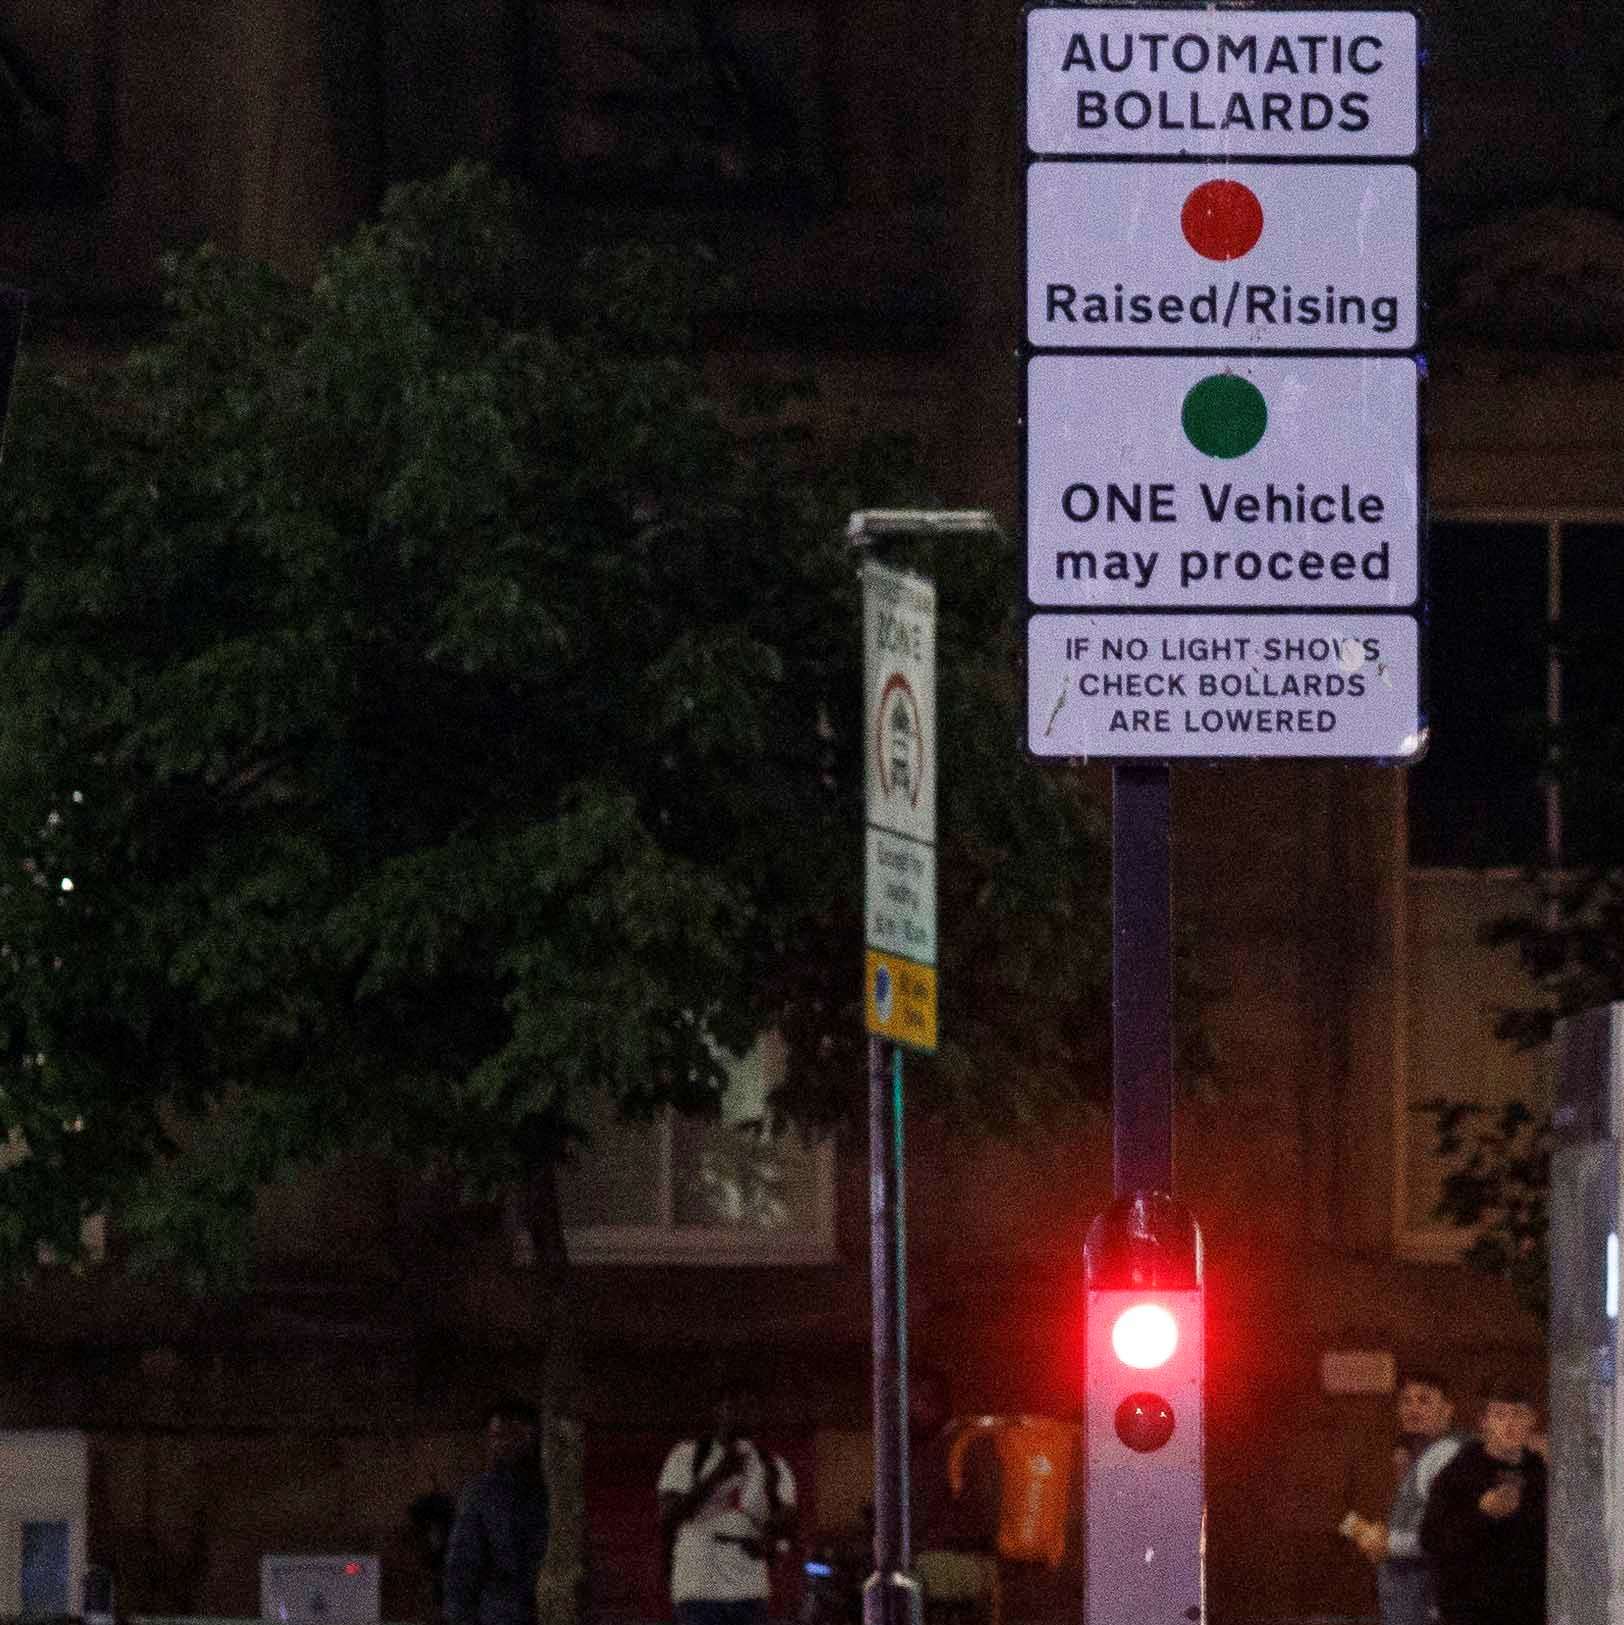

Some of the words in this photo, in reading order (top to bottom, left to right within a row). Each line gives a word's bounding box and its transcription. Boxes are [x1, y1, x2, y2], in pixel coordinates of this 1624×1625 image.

[1061, 33, 1384, 75] AUTOMATIC
[1076, 91, 1370, 132] BOLLARDS
[1046, 281, 1399, 333] Raised/Rising
[1061, 483, 1177, 524] ONE
[1200, 483, 1385, 524] Vehicle
[1055, 550, 1159, 589] may
[1180, 542, 1390, 589] proceed
[1066, 637, 1089, 660] IF
[1102, 638, 1149, 661] NO
[1162, 638, 1251, 662] LIGHT
[1079, 673, 1186, 697] CHECK
[1199, 673, 1366, 697] BOLLARDS
[1109, 709, 1170, 733] ARE
[1185, 709, 1337, 733] LOWERED
